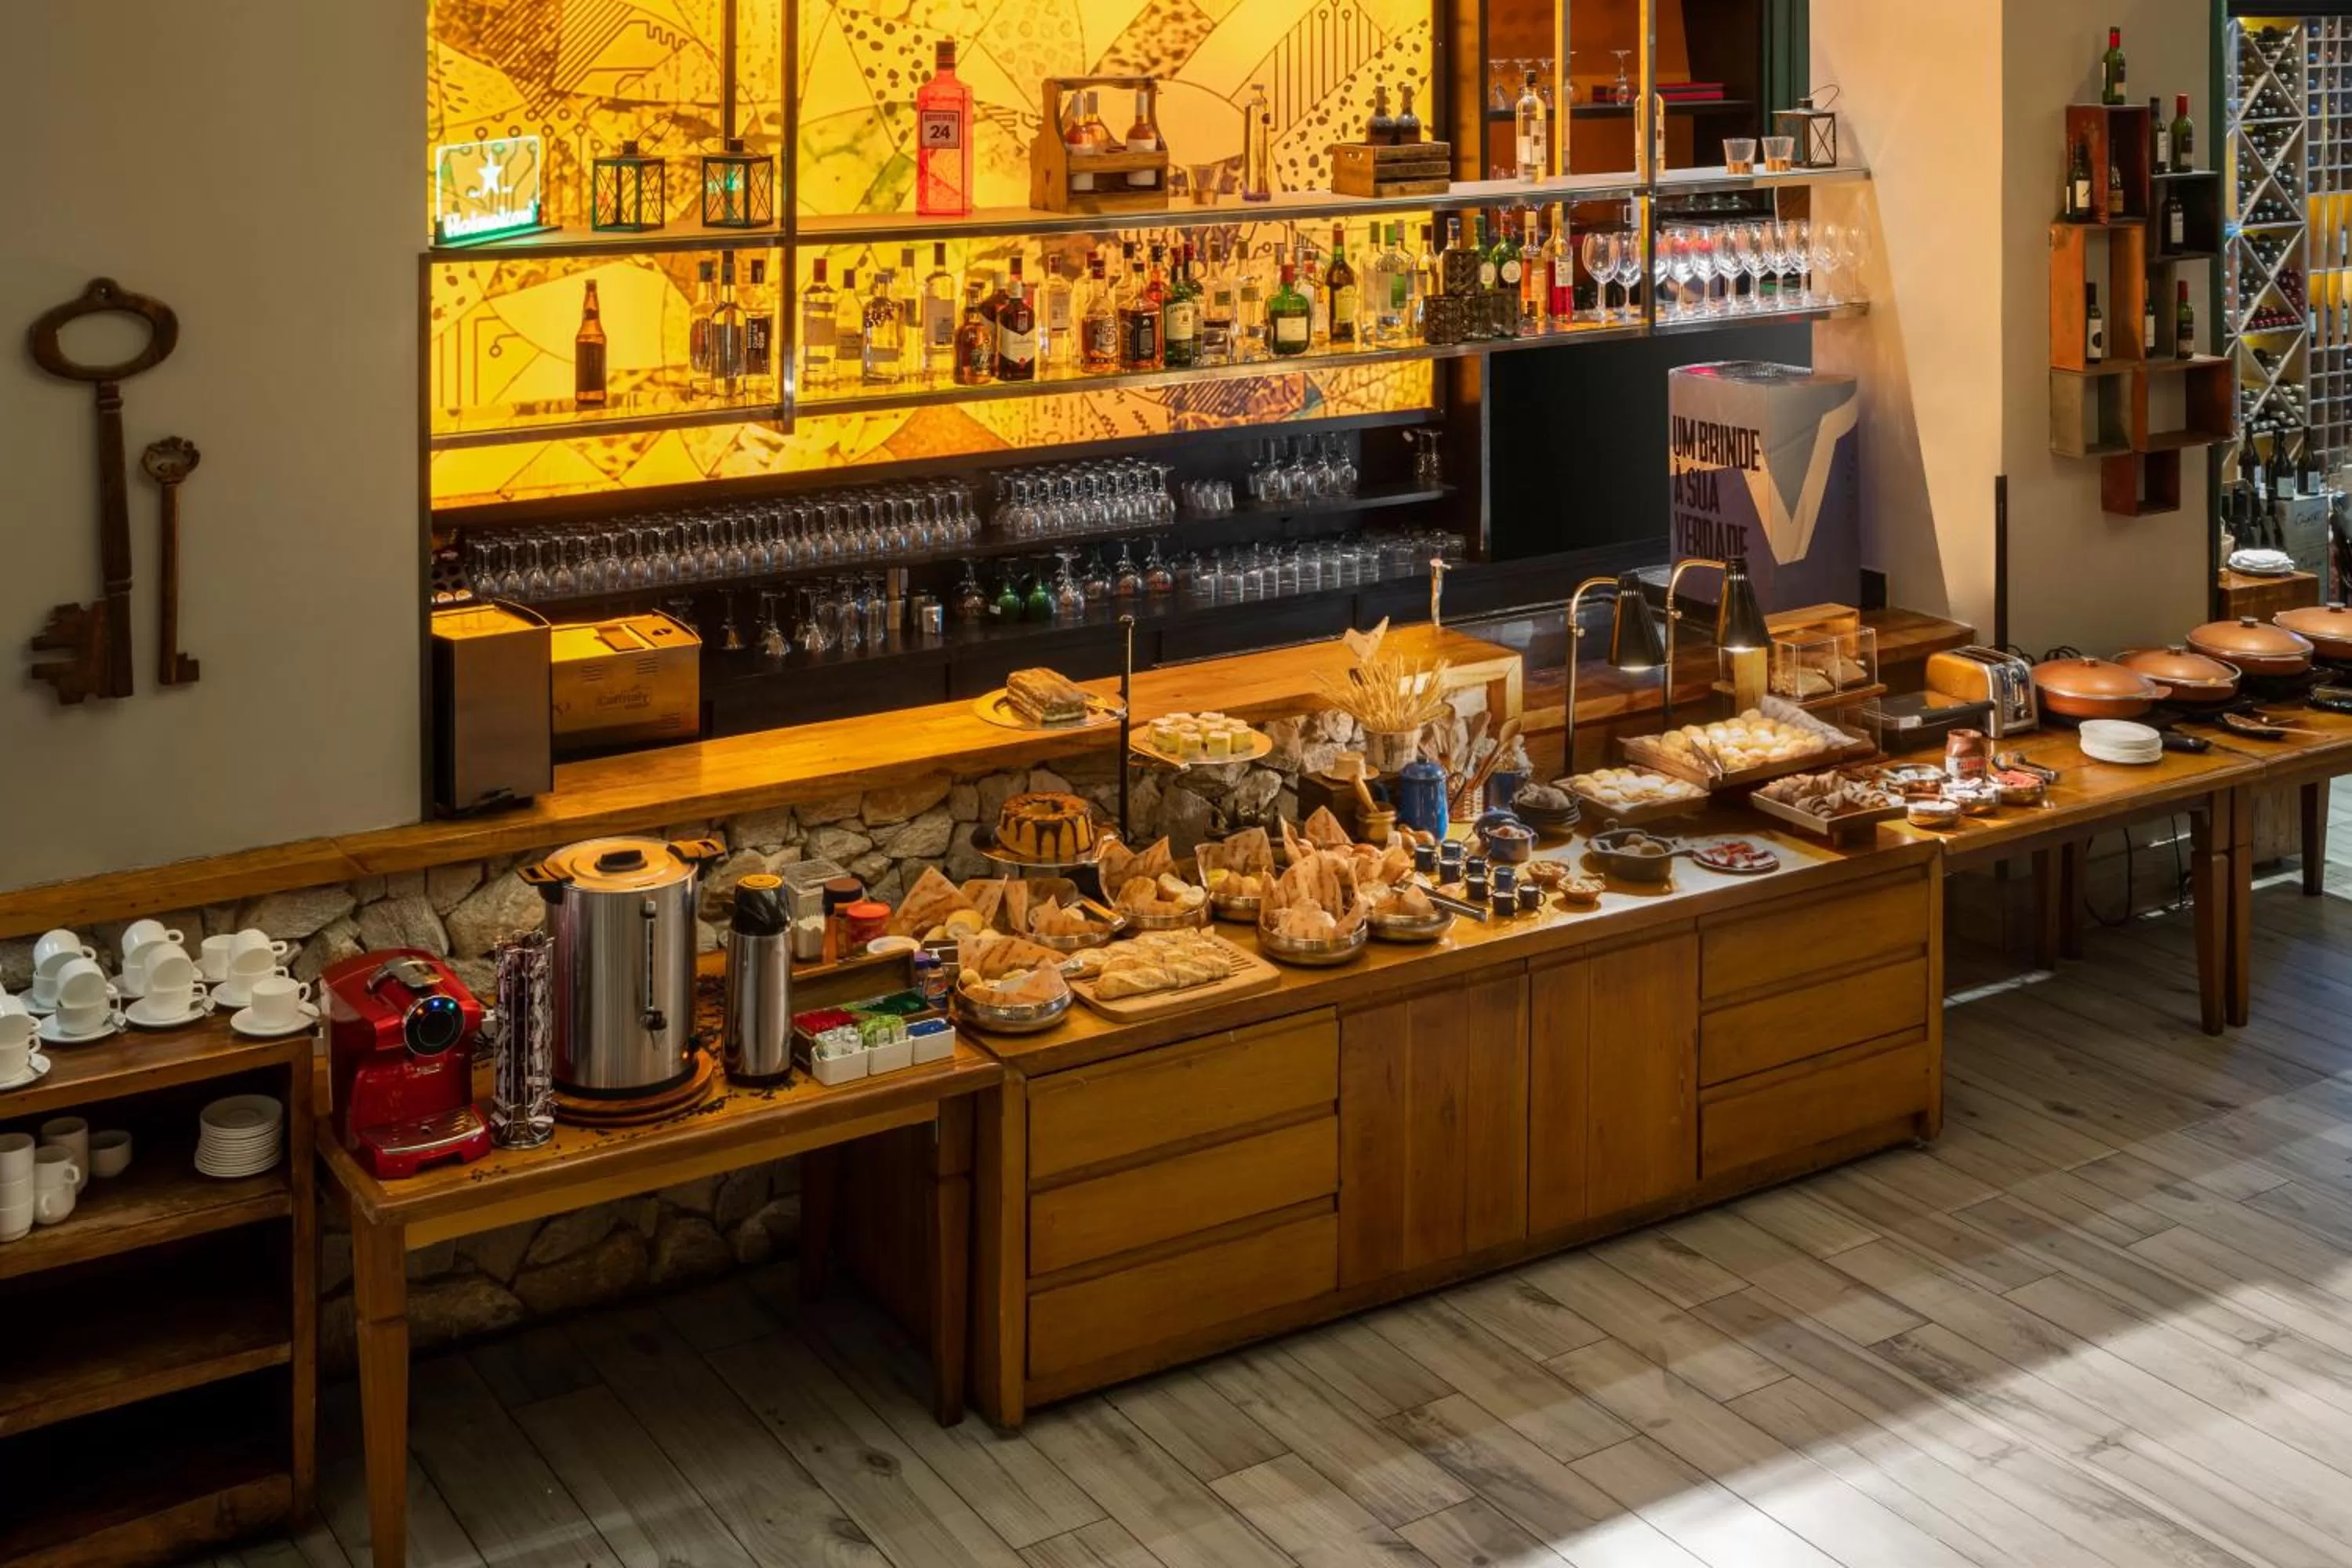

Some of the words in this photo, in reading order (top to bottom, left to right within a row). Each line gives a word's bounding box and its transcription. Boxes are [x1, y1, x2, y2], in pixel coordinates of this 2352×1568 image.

[930, 125, 951, 139] 24
[1672, 415, 1696, 460] UM
[1697, 419, 1761, 473] BRINDE
[1674, 457, 1684, 506] À
[1686, 466, 1721, 515] SUA
[1674, 511, 1748, 562] VERDADE
